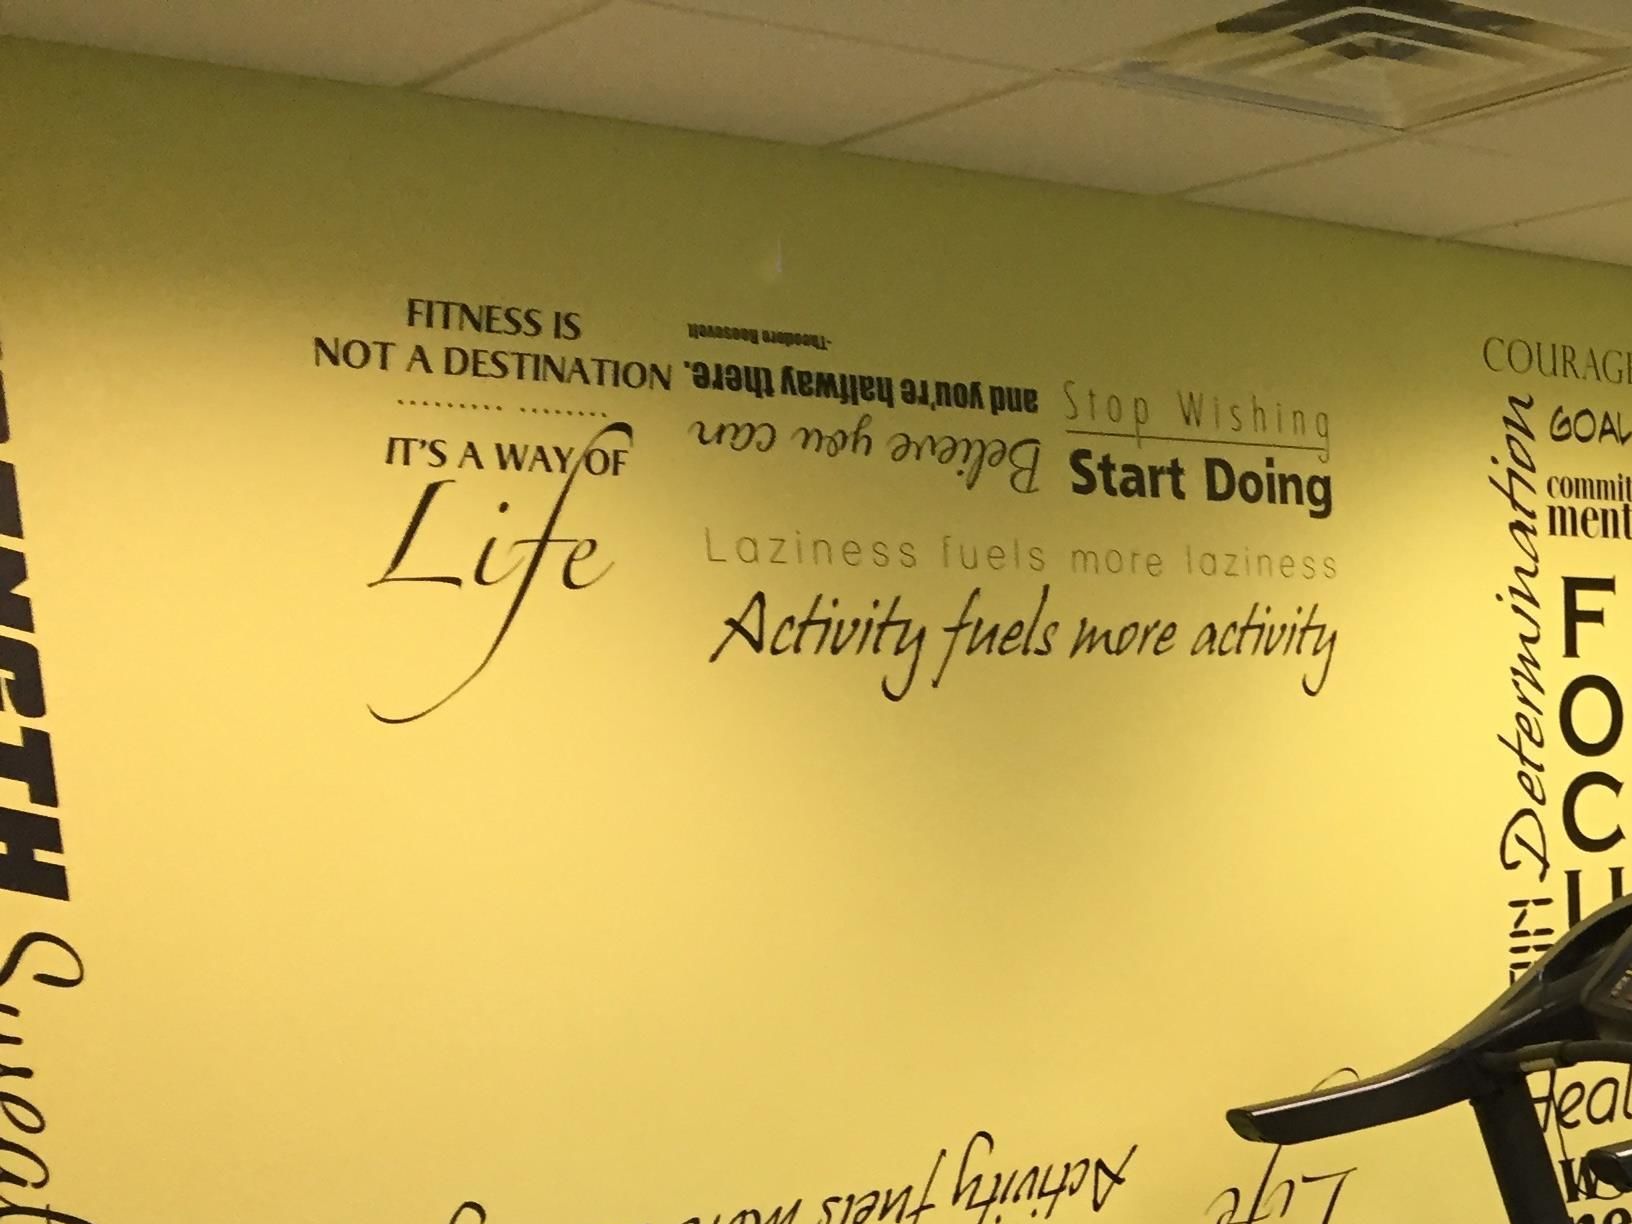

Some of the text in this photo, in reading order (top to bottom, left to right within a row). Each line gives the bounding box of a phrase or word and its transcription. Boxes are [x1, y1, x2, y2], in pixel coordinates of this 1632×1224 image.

[406, 298, 581, 340] FITNESS IS
[313, 338, 671, 391] NOT A DESTINATION
[684, 361, 1038, 415] and you're halfway there.
[1063, 380, 1330, 464] Stop Wishing
[1550, 405, 1632, 445] GOAL
[385, 437, 629, 476] IT'S A WAY OF
[690, 413, 1041, 494] Believe you can
[1069, 449, 1332, 519] Start Doing
[1546, 473, 1632, 502] commit
[1547, 503, 1632, 540] ment
[365, 422, 633, 724] Life
[704, 526, 1337, 579] Laziness fuels more laziness
[709, 584, 1338, 702] Activity fuels more activity
[1488, 393, 1550, 882] Determination
[1559, 575, 1626, 930] FOC
